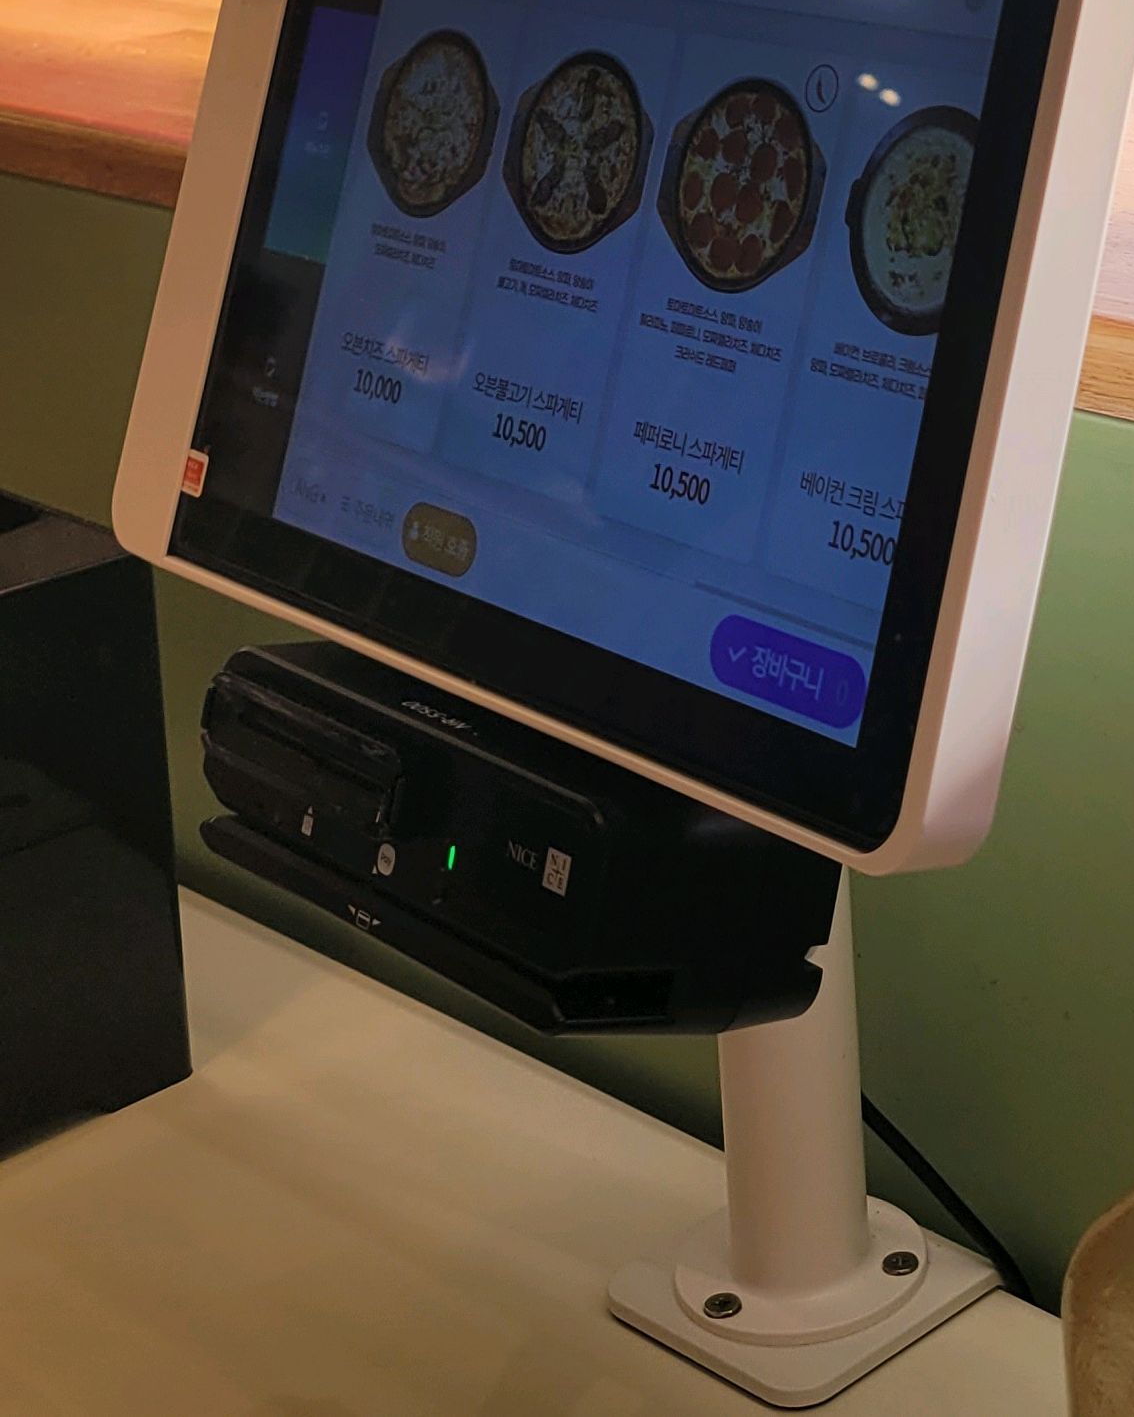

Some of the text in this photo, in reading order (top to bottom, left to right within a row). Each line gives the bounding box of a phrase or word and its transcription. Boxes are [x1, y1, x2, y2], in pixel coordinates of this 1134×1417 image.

[340, 331, 429, 373] 오븐치즈 스파게티
[353, 368, 402, 404] 10,000
[472, 371, 583, 424] 오븐불고기 스파게티
[492, 412, 547, 452] 10,500
[633, 421, 745, 475] 페퍼로니 스파게티
[648, 463, 710, 505] 10,500
[800, 471, 846, 507] 베이컨
[846, 486, 879, 517] 크림
[828, 520, 896, 565] 10,500
[751, 646, 824, 701] 장바구니
[508, 839, 538, 871] NICE
